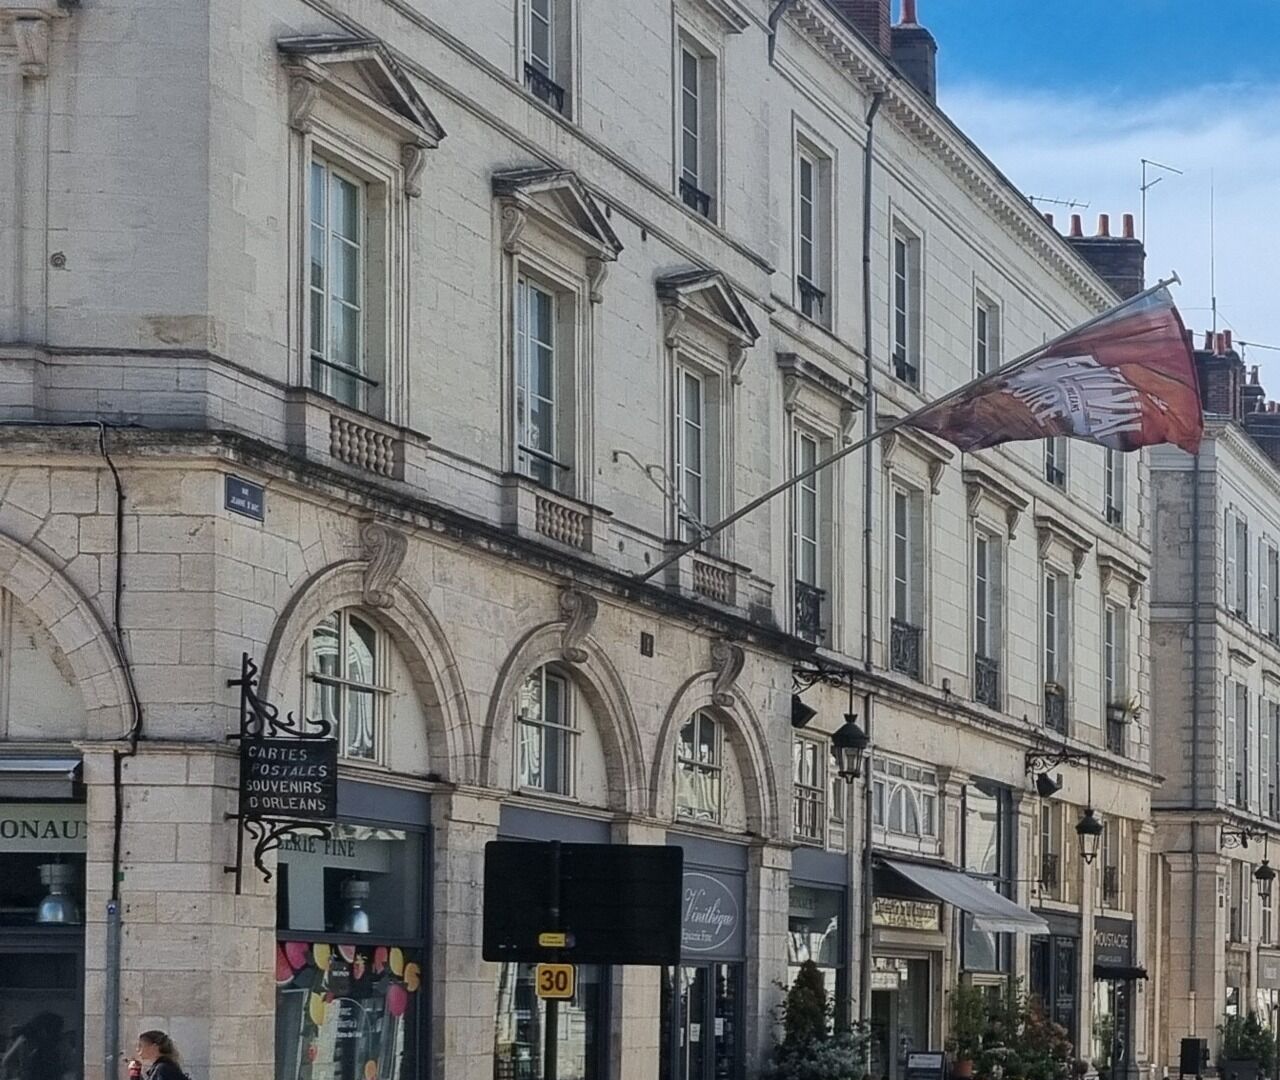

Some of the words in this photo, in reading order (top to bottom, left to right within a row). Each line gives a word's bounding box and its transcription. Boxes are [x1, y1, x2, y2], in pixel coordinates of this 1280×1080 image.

[248, 745, 308, 761] CARTES
[252, 762, 328, 777] POSTALES
[246, 779, 323, 794] SOUVENIRS
[324, 839, 356, 858] FINE
[540, 970, 568, 991] 30
